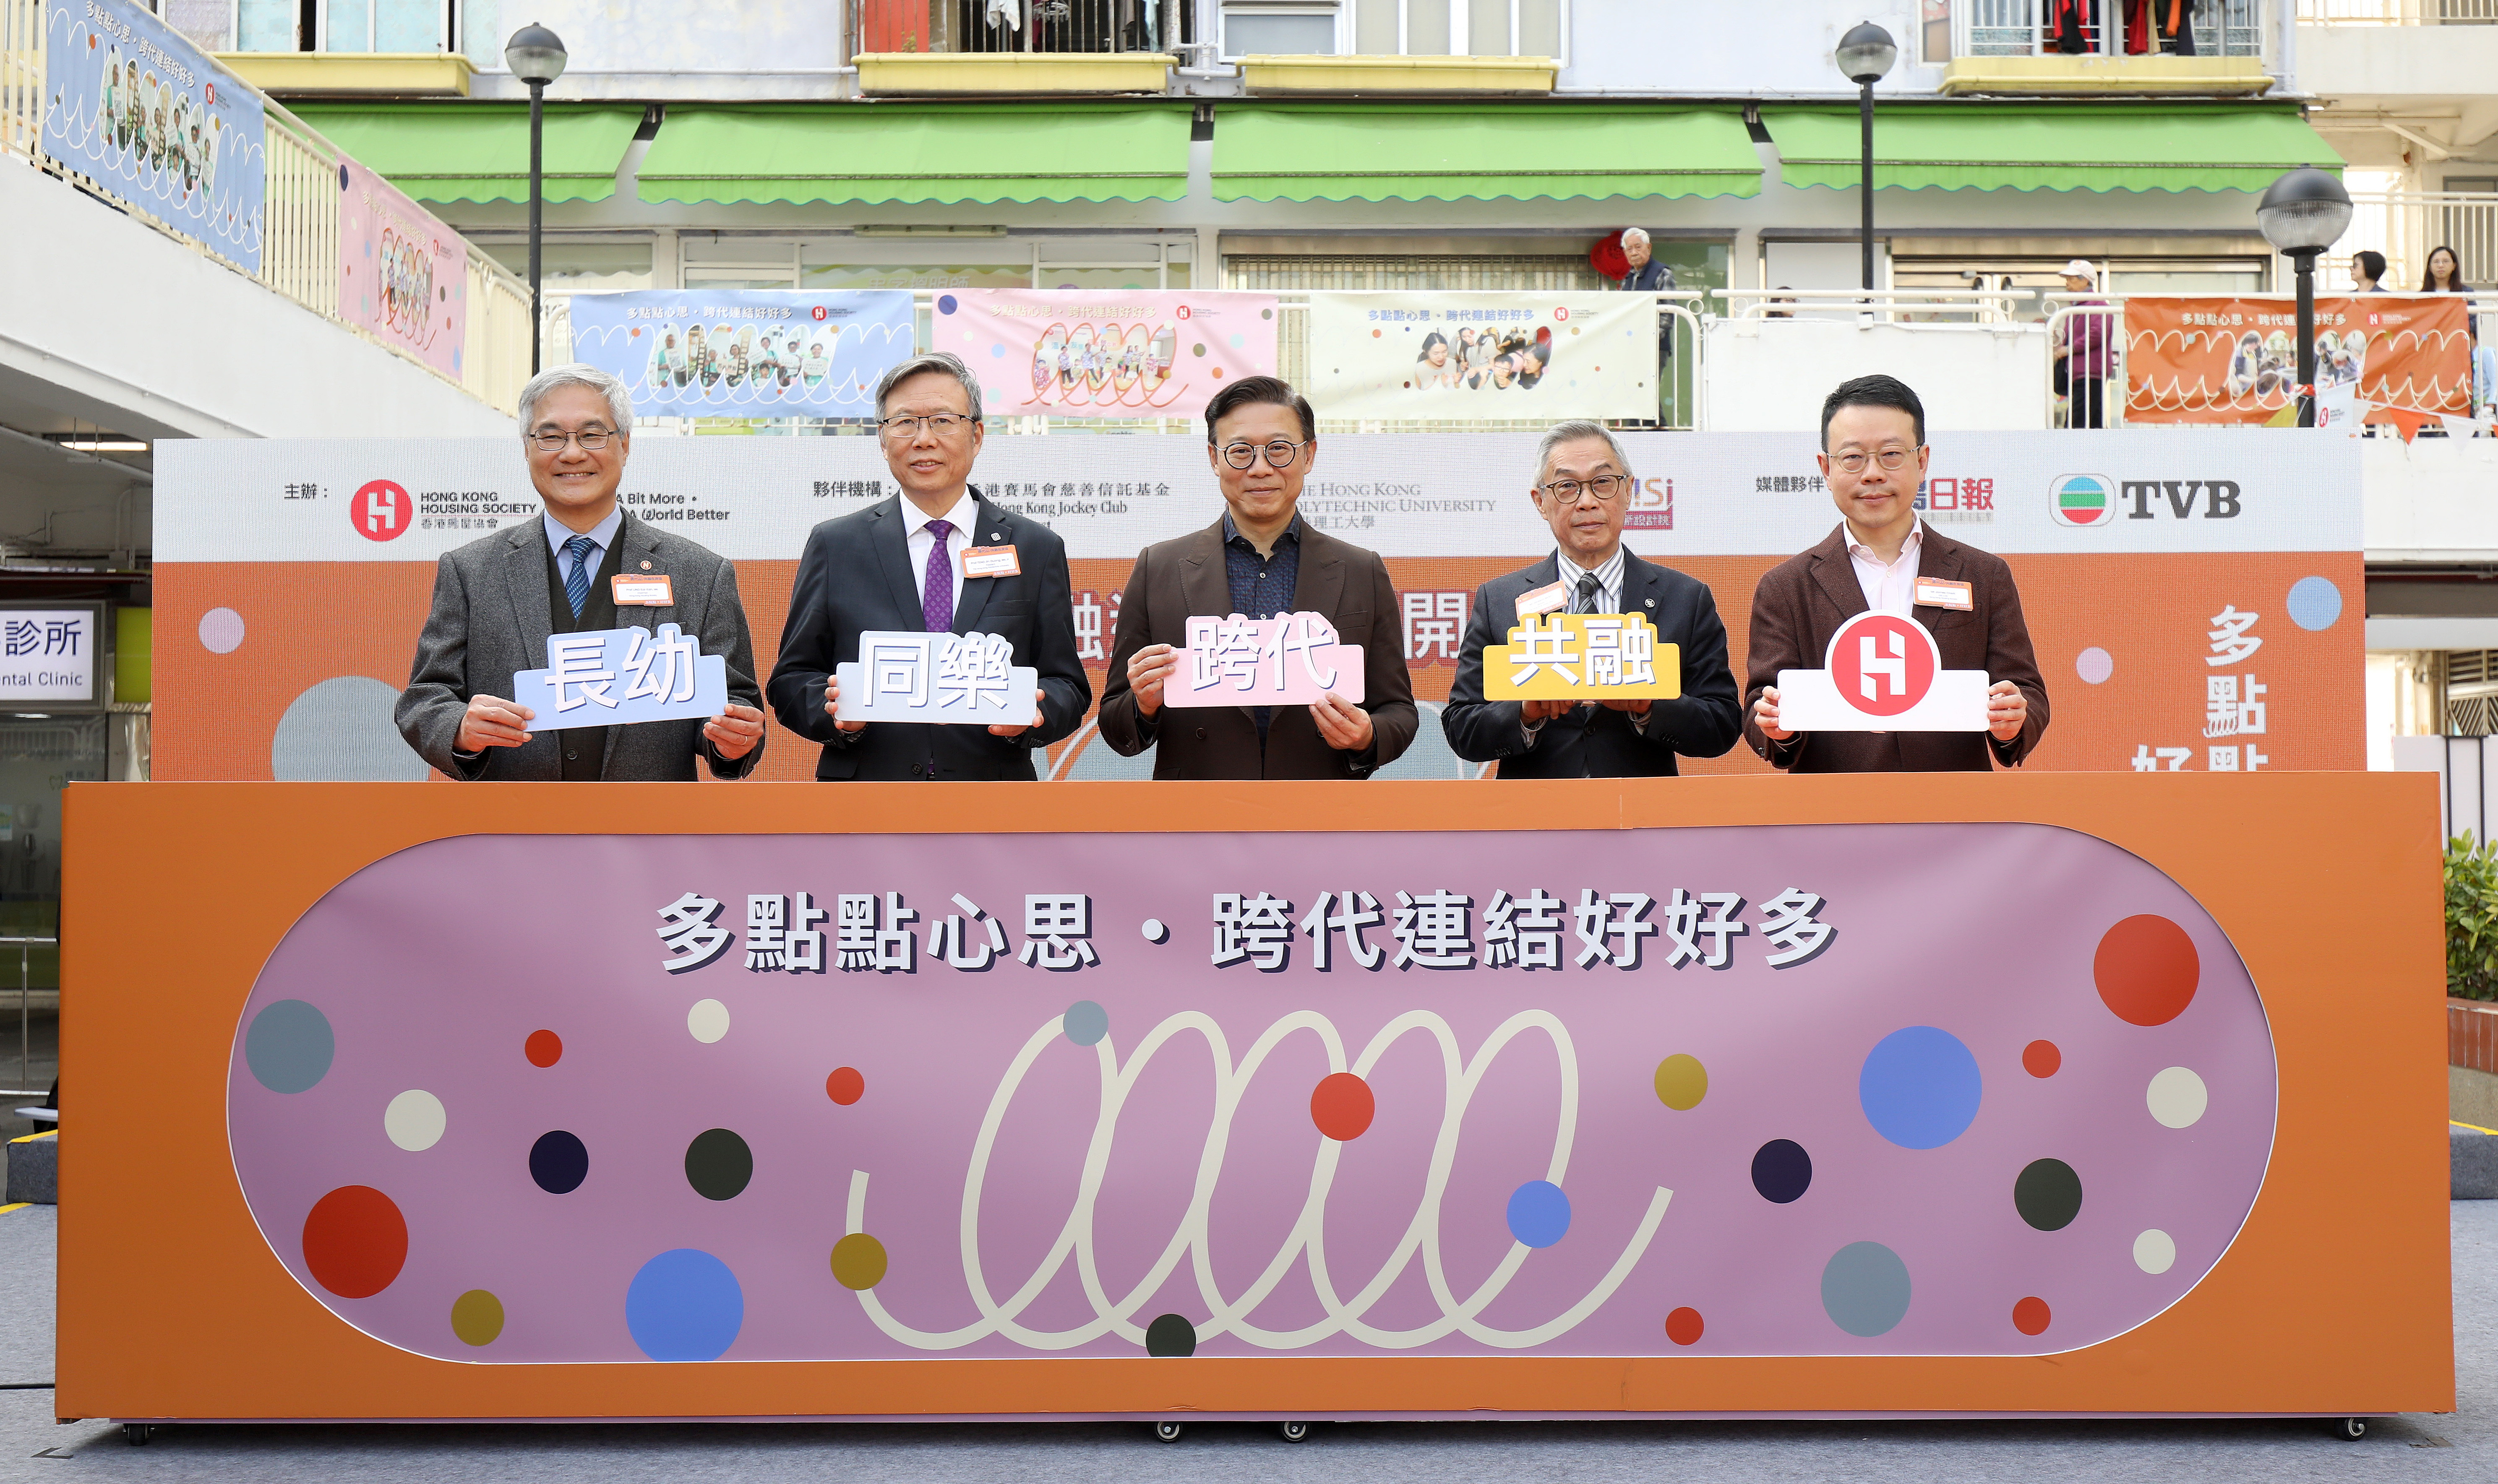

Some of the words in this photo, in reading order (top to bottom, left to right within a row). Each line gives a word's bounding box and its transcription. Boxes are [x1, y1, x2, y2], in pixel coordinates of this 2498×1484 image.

[1320, 483, 1370, 496] HONG
[1375, 483, 1421, 496] KONG
[1756, 476, 1824, 492] 媒體夥伴
[421, 492, 458, 502] HONG
[462, 492, 498, 502] KONG
[628, 493, 645, 504] Bit
[650, 493, 684, 504] More
[2121, 480, 2240, 519] TVB
[421, 504, 478, 513] HOUSING
[482, 504, 537, 513] SOCIETY
[1026, 501, 1056, 515] Kong
[1057, 501, 1097, 517] Jockey
[1101, 501, 1129, 514] Club
[1399, 499, 1497, 513] UNIVERSITY
[687, 509, 730, 520] Better
[0, 620, 81, 656] 診所
[1191, 617, 1338, 692] 跨代
[1510, 617, 1656, 687] 共融
[38, 671, 82, 686] Clinic
[545, 630, 695, 713] 長幼
[863, 637, 1010, 710] 同樂
[655, 887, 1840, 974] 多點點心思・跨代連結好好多
